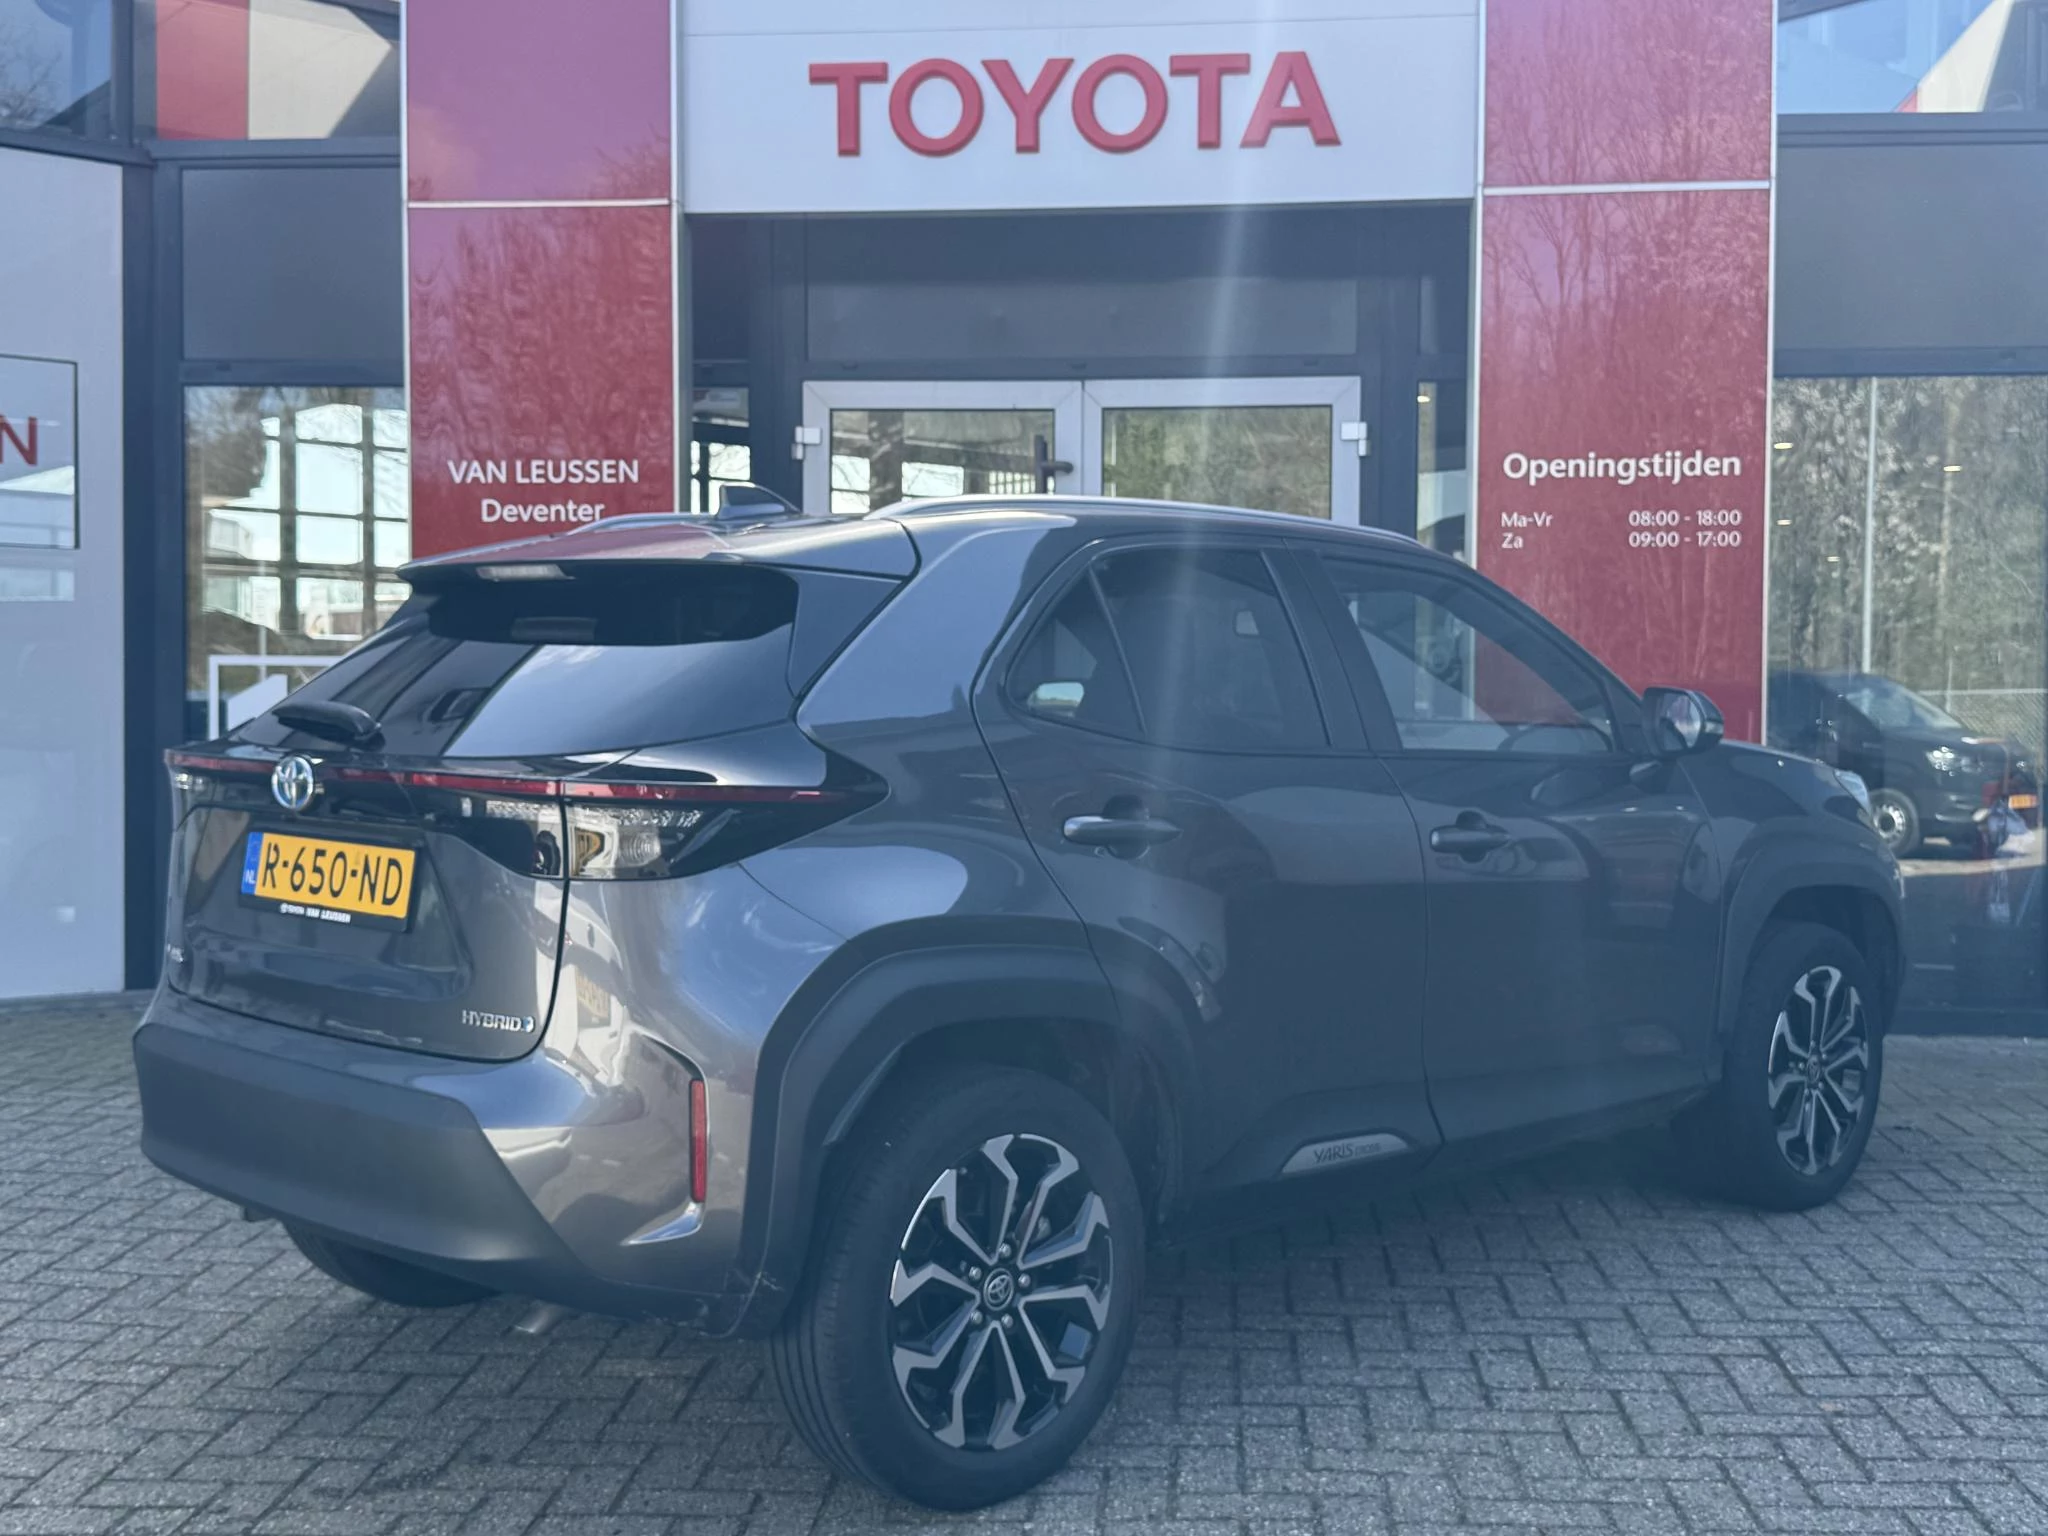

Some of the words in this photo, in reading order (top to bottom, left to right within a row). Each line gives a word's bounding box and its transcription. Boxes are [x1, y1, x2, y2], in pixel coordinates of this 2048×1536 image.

[809, 51, 1342, 157] TOYOTA
[447, 459, 507, 484] VAN
[515, 459, 639, 484] LEUSSEN
[1503, 450, 1742, 486] Openingstijden
[481, 498, 606, 523] Deventer
[1501, 512, 1553, 528] Ma-Vr
[1628, 510, 1680, 527] 08:00
[1696, 509, 1742, 526] 18:00
[1501, 533, 1524, 549] Za
[1628, 531, 1680, 548] 09:00
[1696, 531, 1742, 547] 17:00
[262, 842, 403, 906] R-650-ND
[462, 1009, 522, 1032] HYBRID
[1312, 1143, 1354, 1163] YARIS
